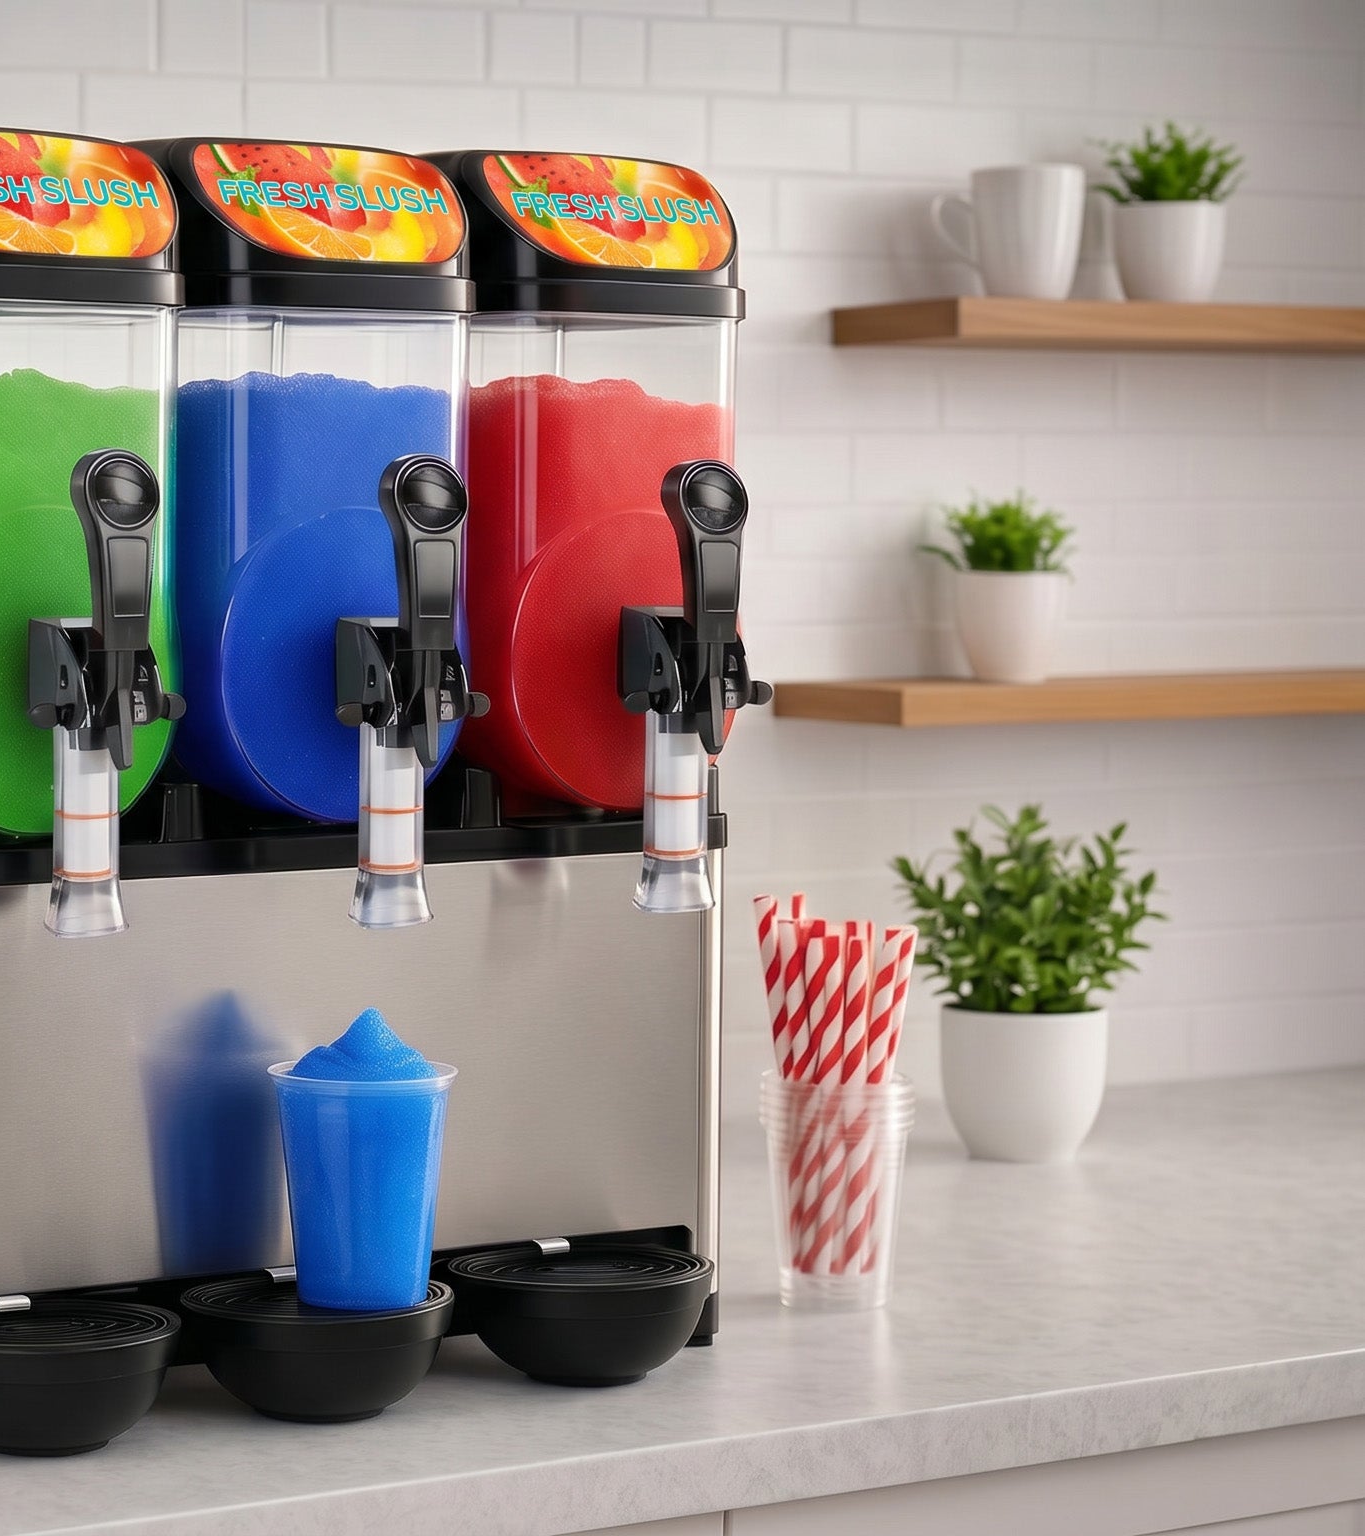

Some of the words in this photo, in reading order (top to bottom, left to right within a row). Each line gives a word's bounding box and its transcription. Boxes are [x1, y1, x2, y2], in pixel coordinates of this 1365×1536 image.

[39, 176, 160, 208] SLUSH
[217, 179, 332, 209] FRESH
[334, 184, 449, 215] SLUSH
[510, 191, 617, 220] FRESH
[617, 195, 720, 225] SLUSH
